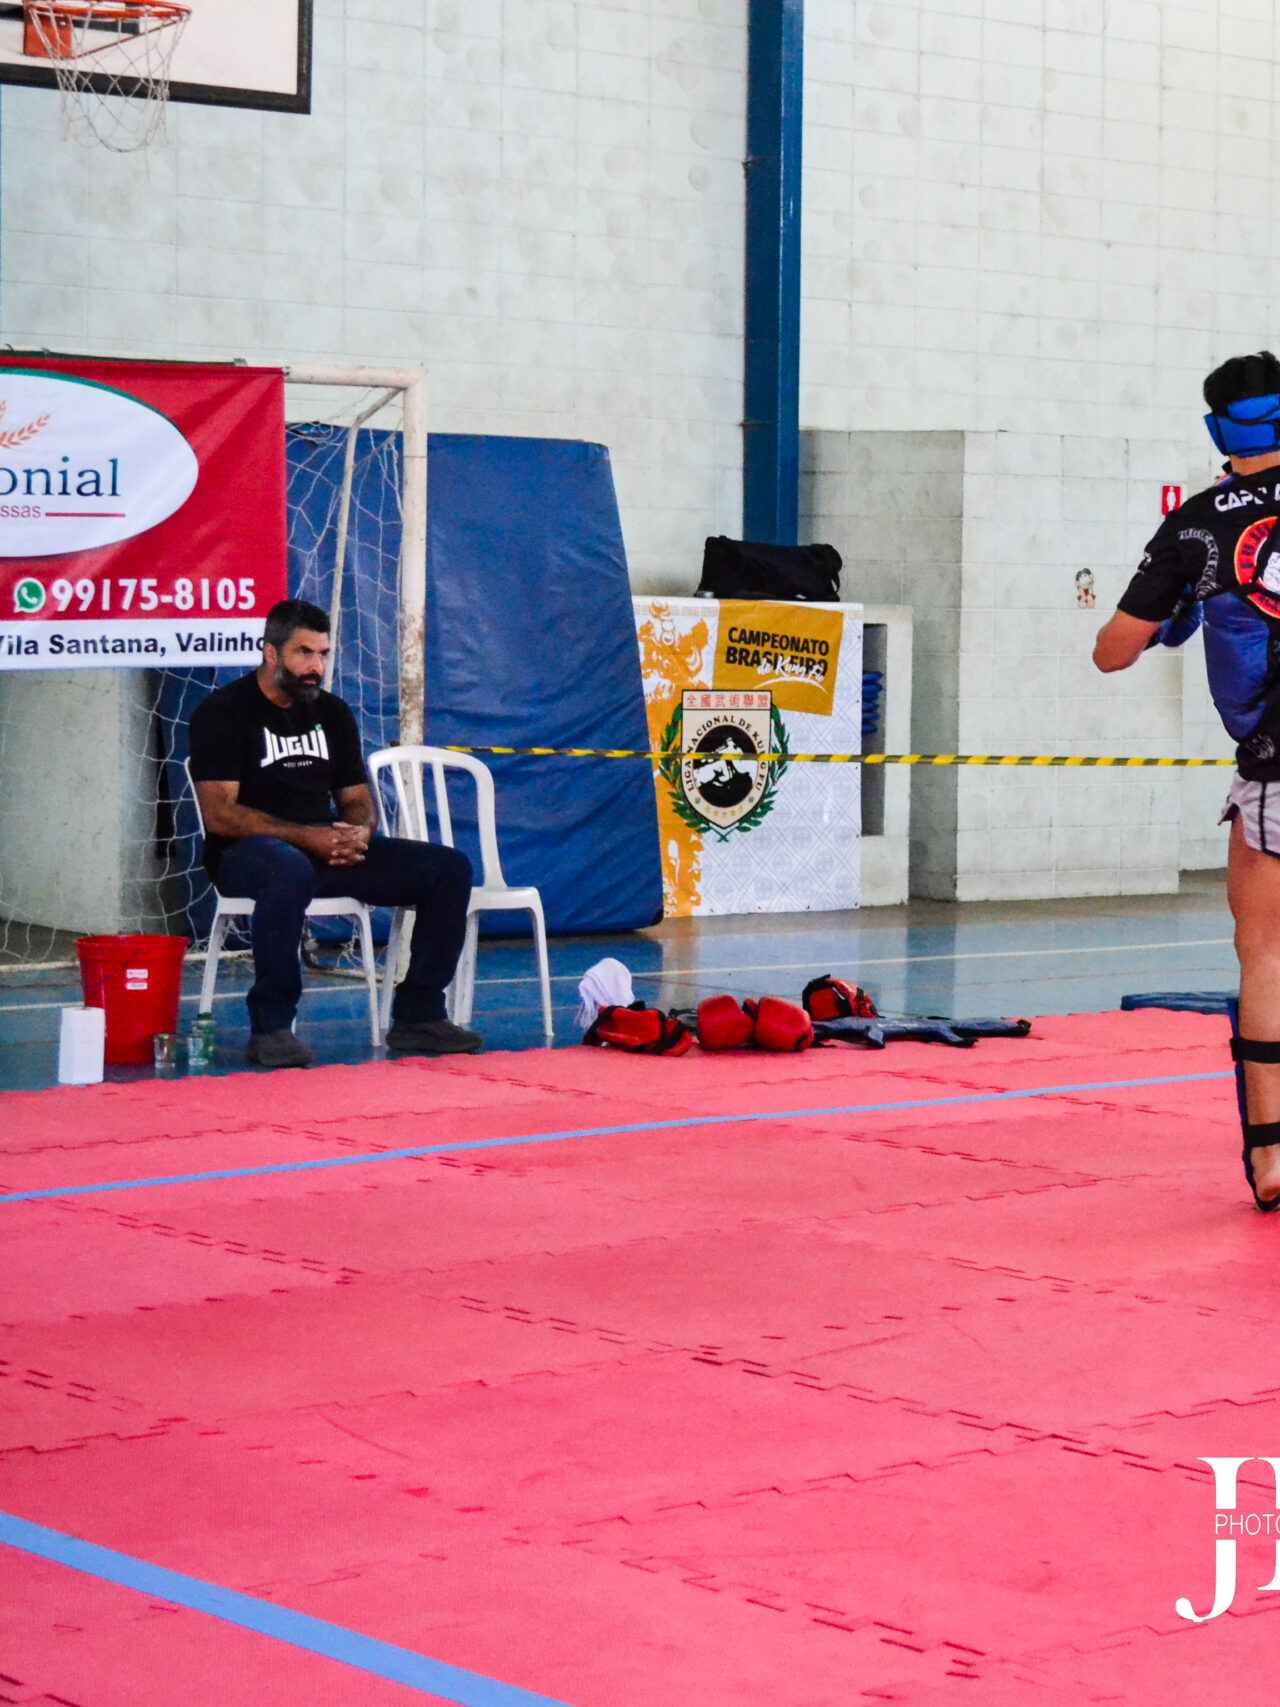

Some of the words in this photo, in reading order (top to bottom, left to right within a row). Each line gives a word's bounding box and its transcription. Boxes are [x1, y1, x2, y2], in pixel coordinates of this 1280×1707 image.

[51, 578, 256, 612] 99175-8105
[49, 633, 166, 658] Santana,
[728, 627, 830, 656] CAMPEONATO
[687, 715, 736, 754] NACIONAL
[739, 718, 753, 732] DE
[260, 723, 329, 768] JUGUI
[752, 731, 768, 770] KUG
[684, 761, 694, 792] LIGA
[755, 774, 765, 791] FU
